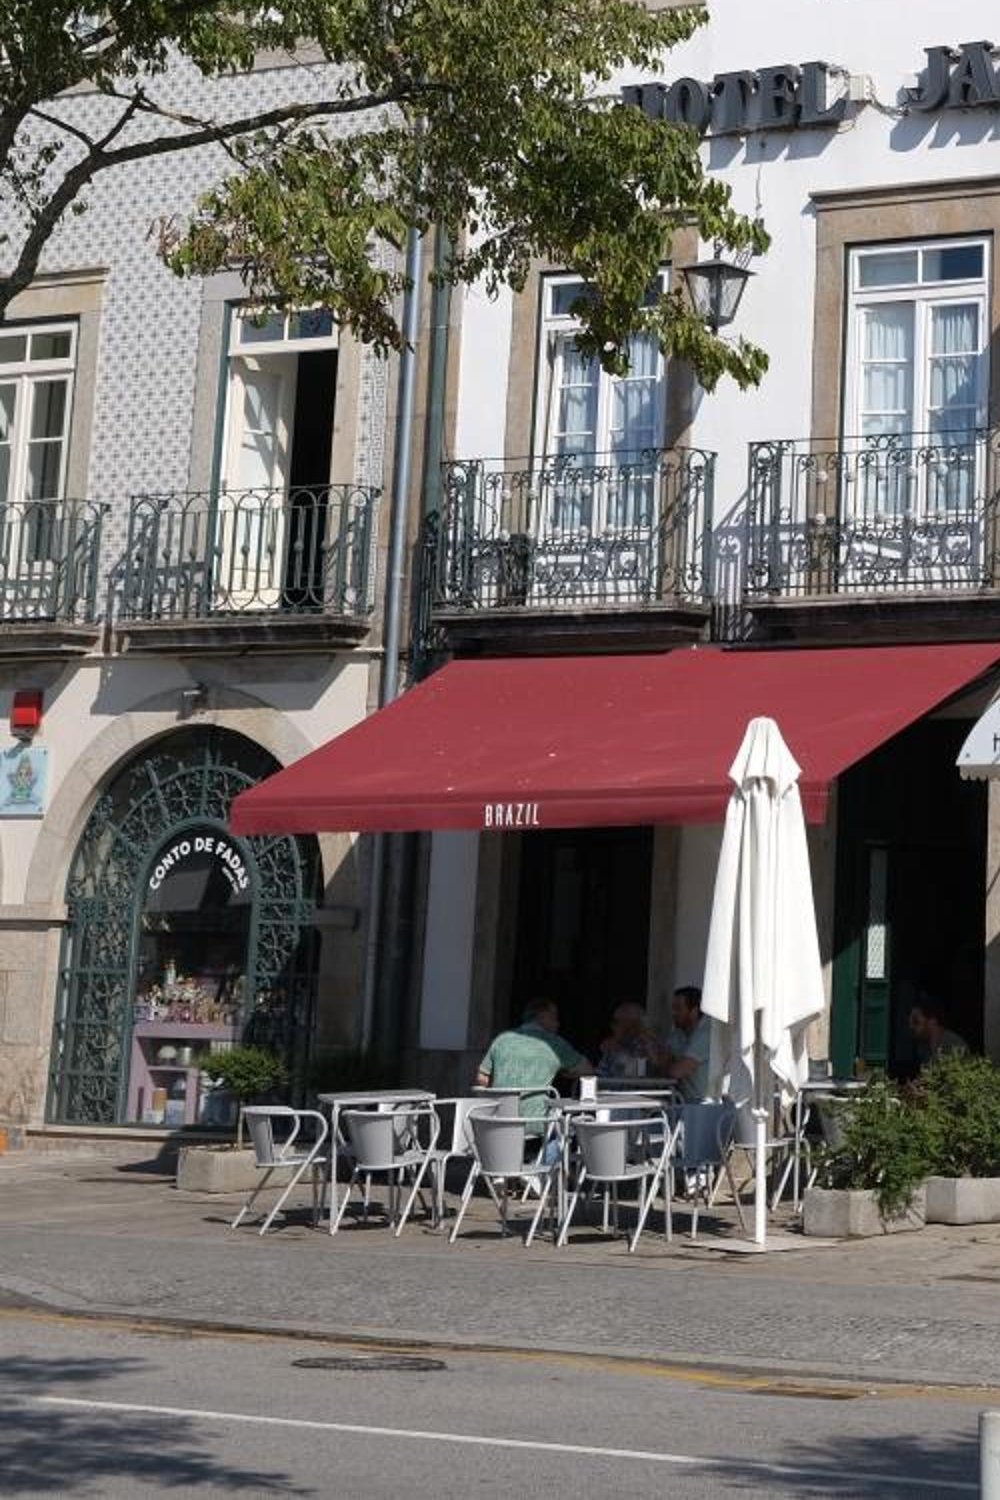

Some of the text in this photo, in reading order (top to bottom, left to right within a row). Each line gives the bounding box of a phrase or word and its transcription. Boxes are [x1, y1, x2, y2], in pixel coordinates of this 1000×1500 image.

[484, 803, 540, 828] BRAZIL
[149, 841, 191, 890] CONTO
[194, 837, 215, 853] DE
[215, 841, 249, 889] FADAS
